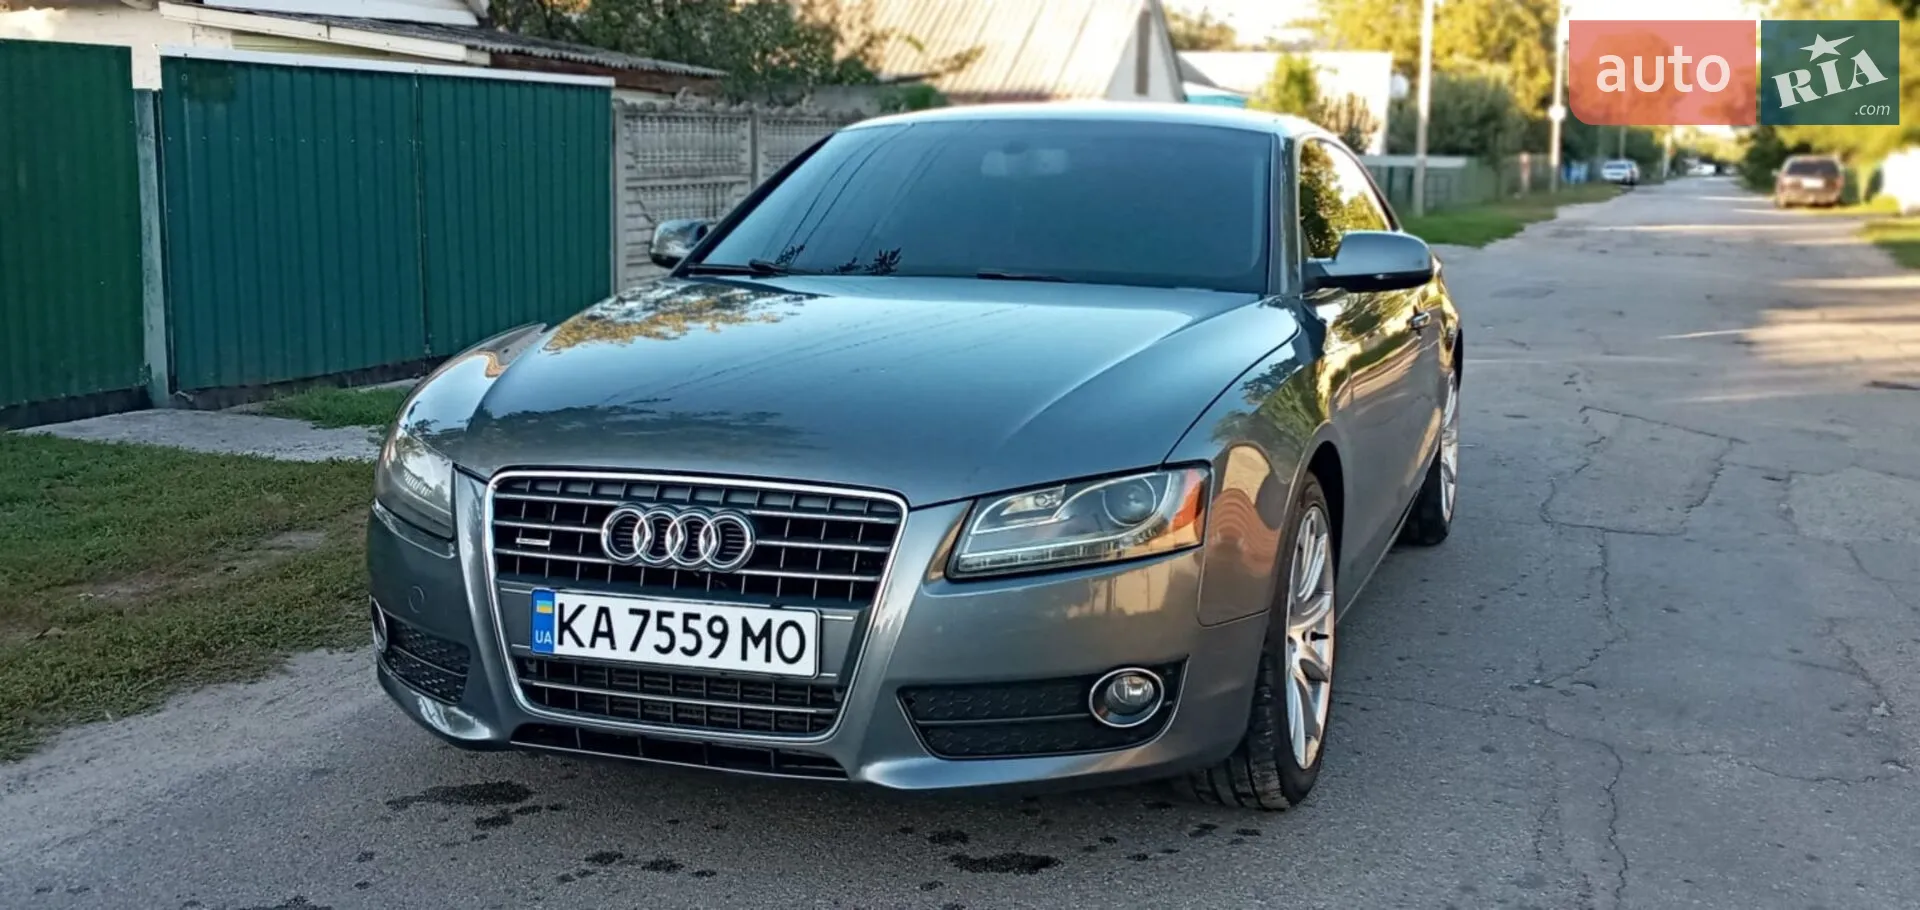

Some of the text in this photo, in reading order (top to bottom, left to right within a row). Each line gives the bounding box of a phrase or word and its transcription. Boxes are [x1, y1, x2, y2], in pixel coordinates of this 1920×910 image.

[535, 629, 552, 645] UA
[557, 602, 806, 665] KA 7559 MO
